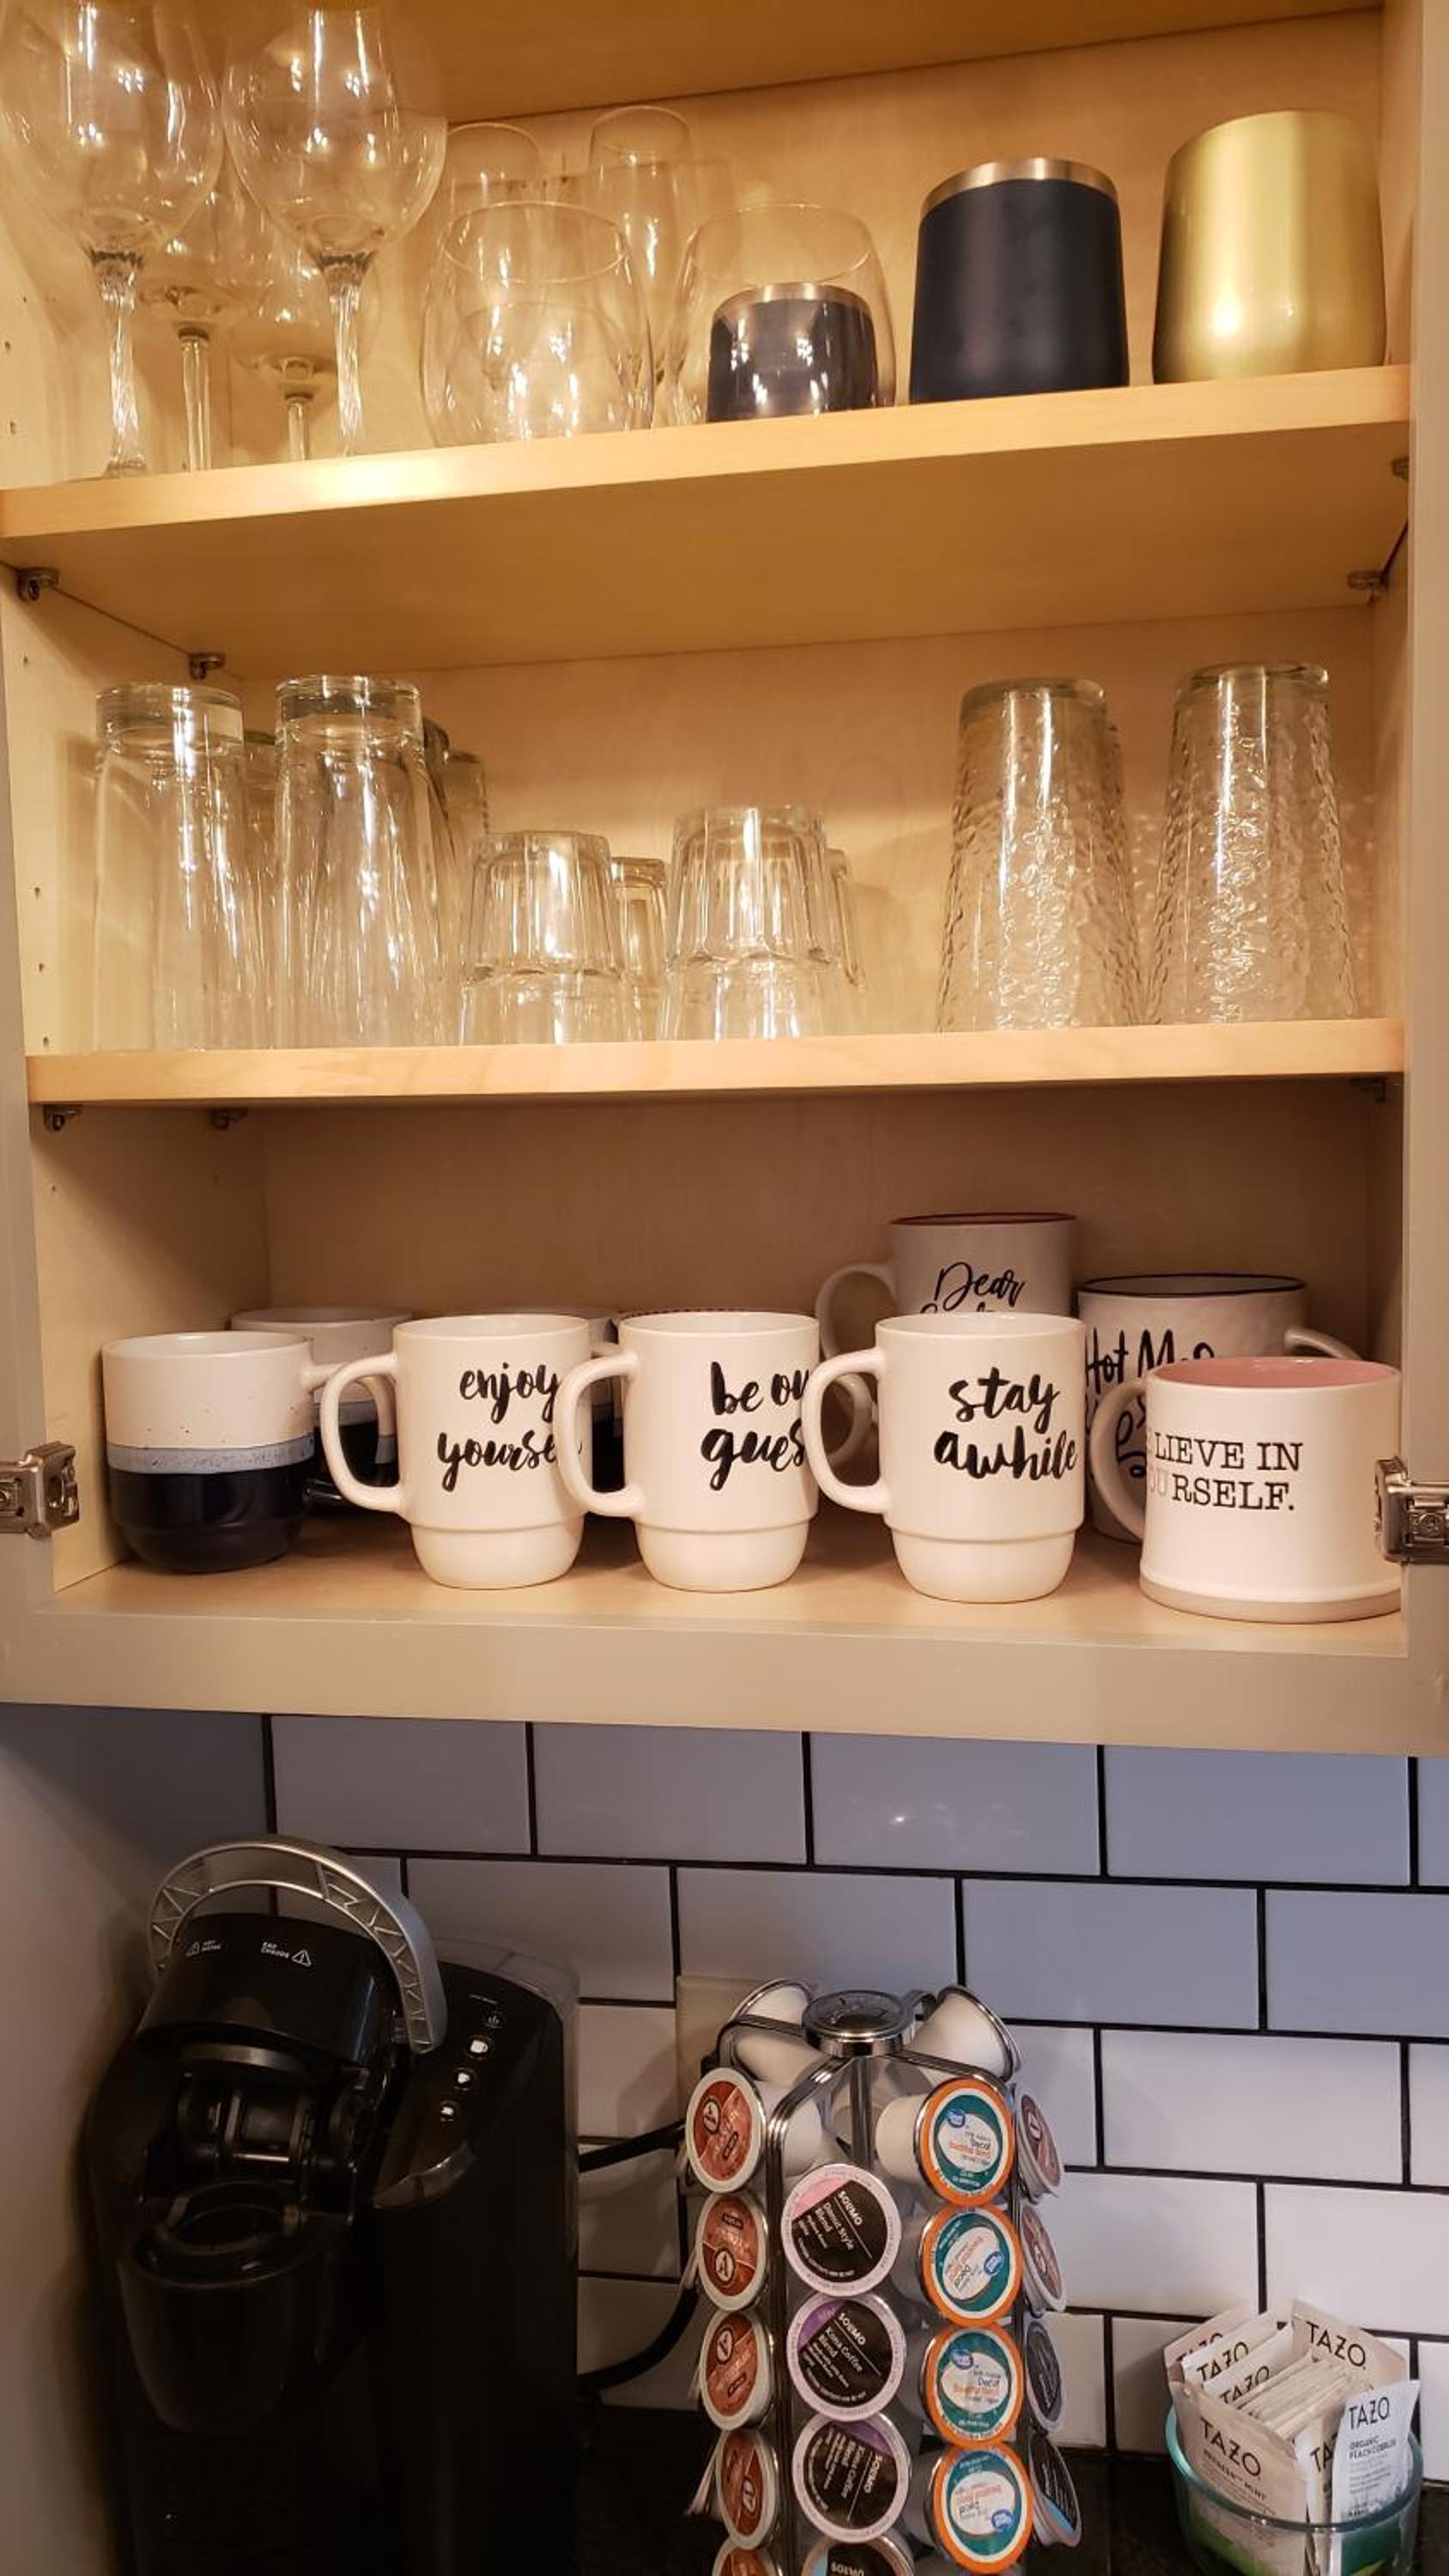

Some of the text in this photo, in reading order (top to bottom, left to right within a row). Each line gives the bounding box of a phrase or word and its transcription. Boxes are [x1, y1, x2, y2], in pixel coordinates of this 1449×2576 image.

[933, 1261, 1025, 1311] Dear
[459, 1362, 561, 1425] enjoy
[711, 1361, 809, 1415] be ou
[949, 1366, 1061, 1434] stay
[438, 1430, 557, 1492] yourse
[700, 1418, 805, 1492] gues
[934, 1425, 1078, 1481] awhile
[1154, 1431, 1304, 1471] LIEVE IN
[818, 2334, 839, 2358] Blend
[825, 2326, 842, 2349] Kona
[840, 2347, 863, 2372] Coffee
[1349, 2397, 1390, 2430] TAZO
